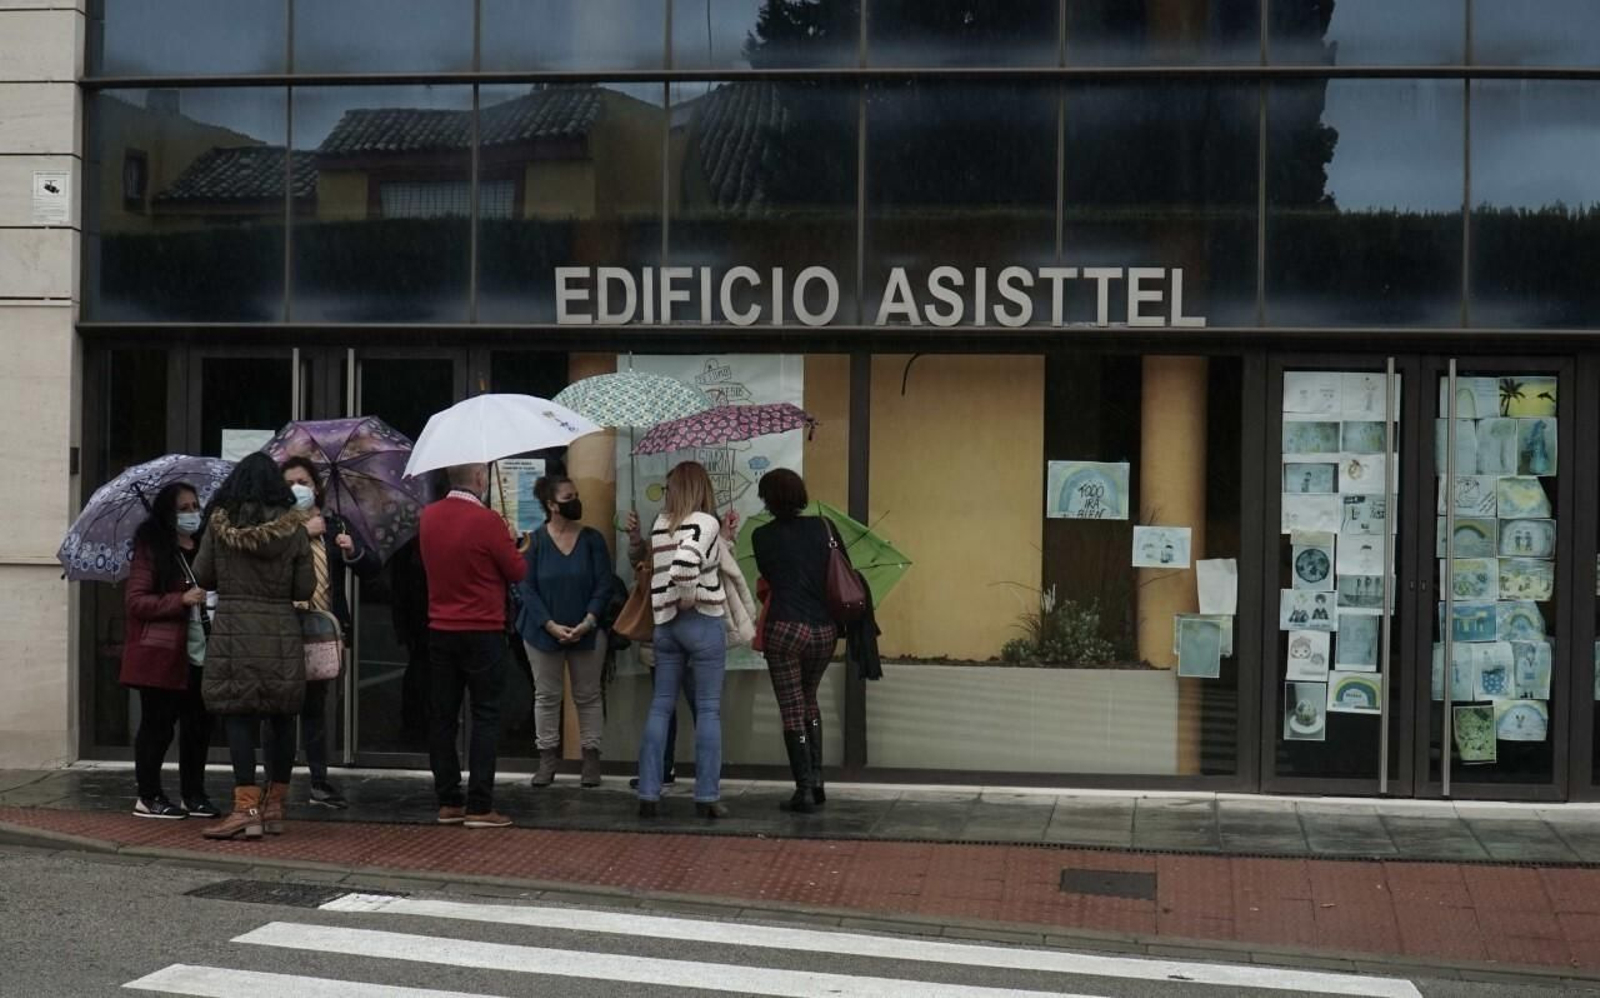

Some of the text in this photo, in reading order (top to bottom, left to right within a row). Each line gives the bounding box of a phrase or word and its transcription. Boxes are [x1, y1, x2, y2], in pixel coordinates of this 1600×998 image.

[555, 266, 1206, 327] EDIFICIO ASISTTEL
[1078, 483, 1105, 499] TODO
